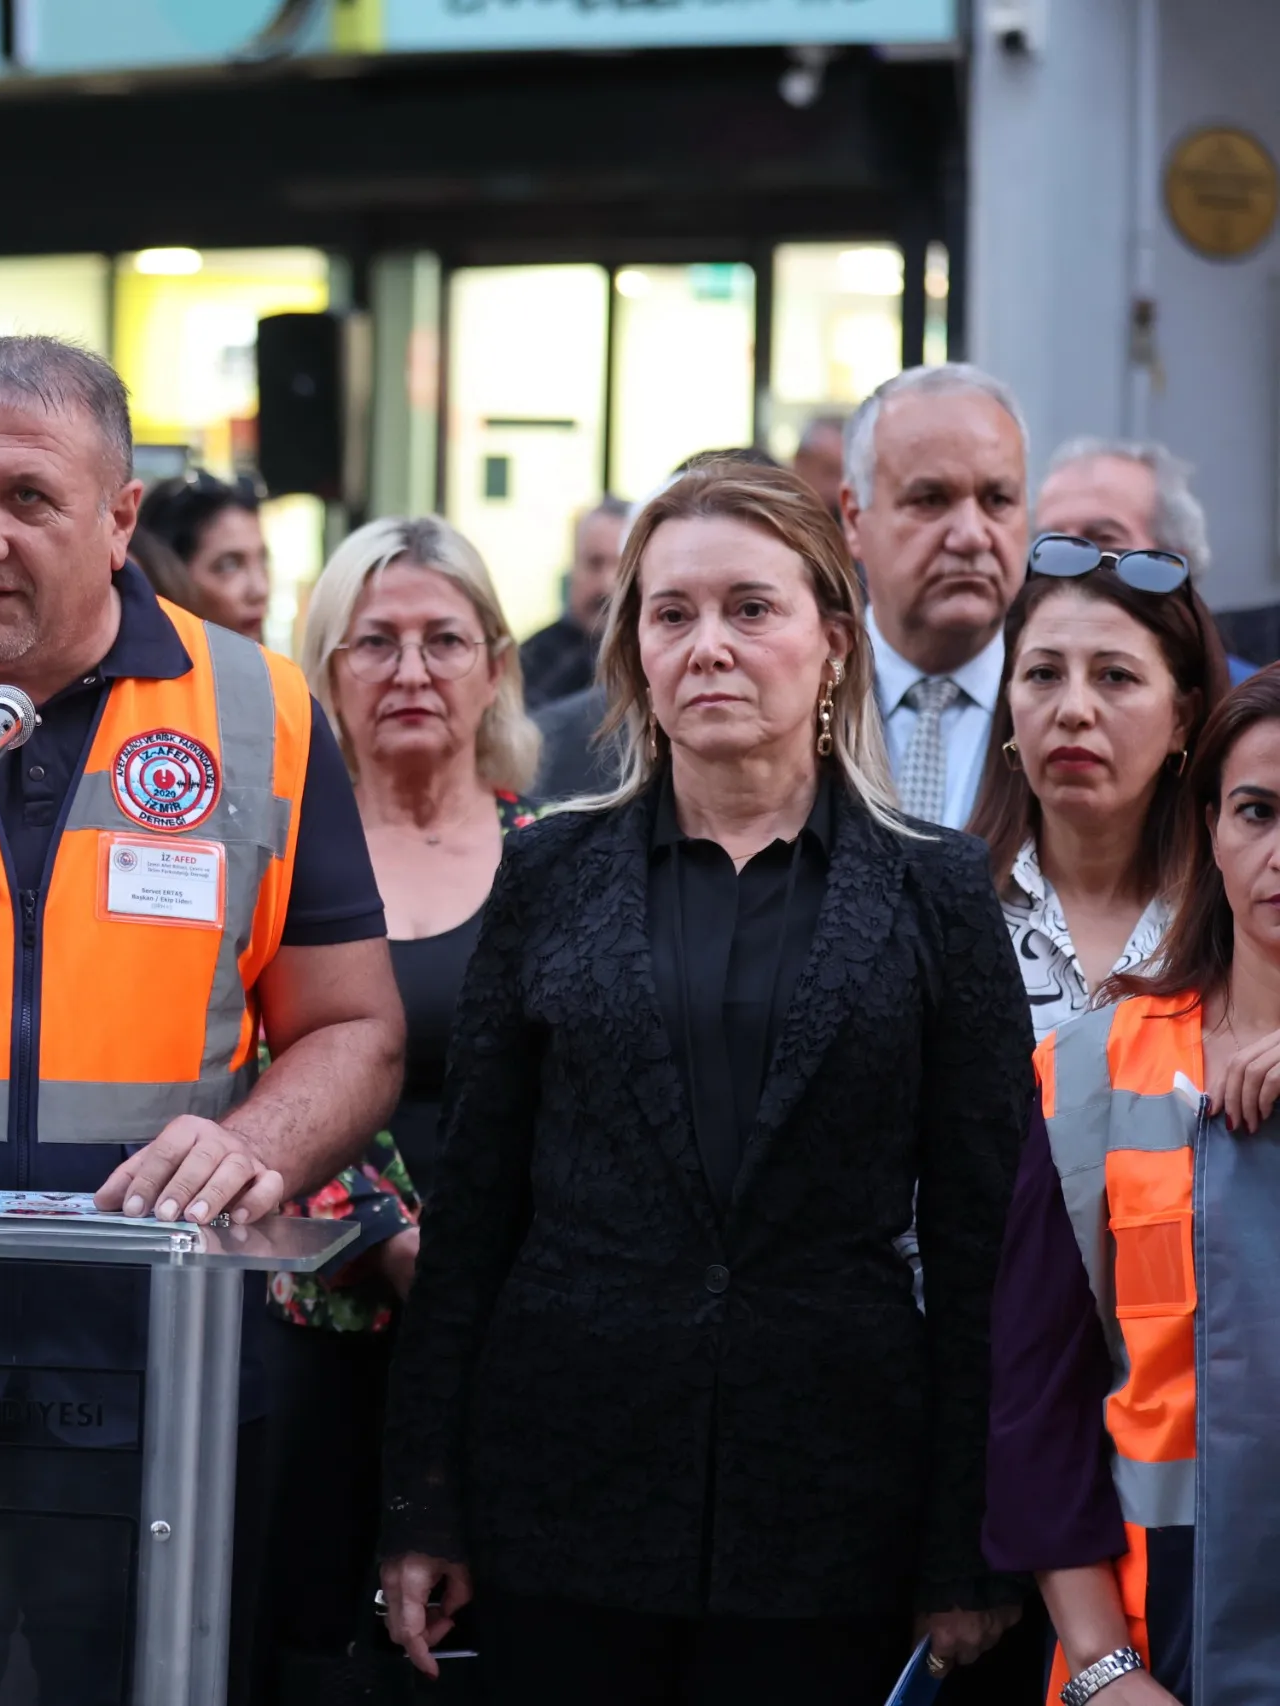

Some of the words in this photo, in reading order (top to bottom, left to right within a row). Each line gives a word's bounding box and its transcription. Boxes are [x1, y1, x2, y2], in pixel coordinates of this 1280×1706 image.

[153, 788, 177, 798] 2020
[144, 797, 182, 813] İZMİR
[161, 851, 197, 864] İZ-AFED
